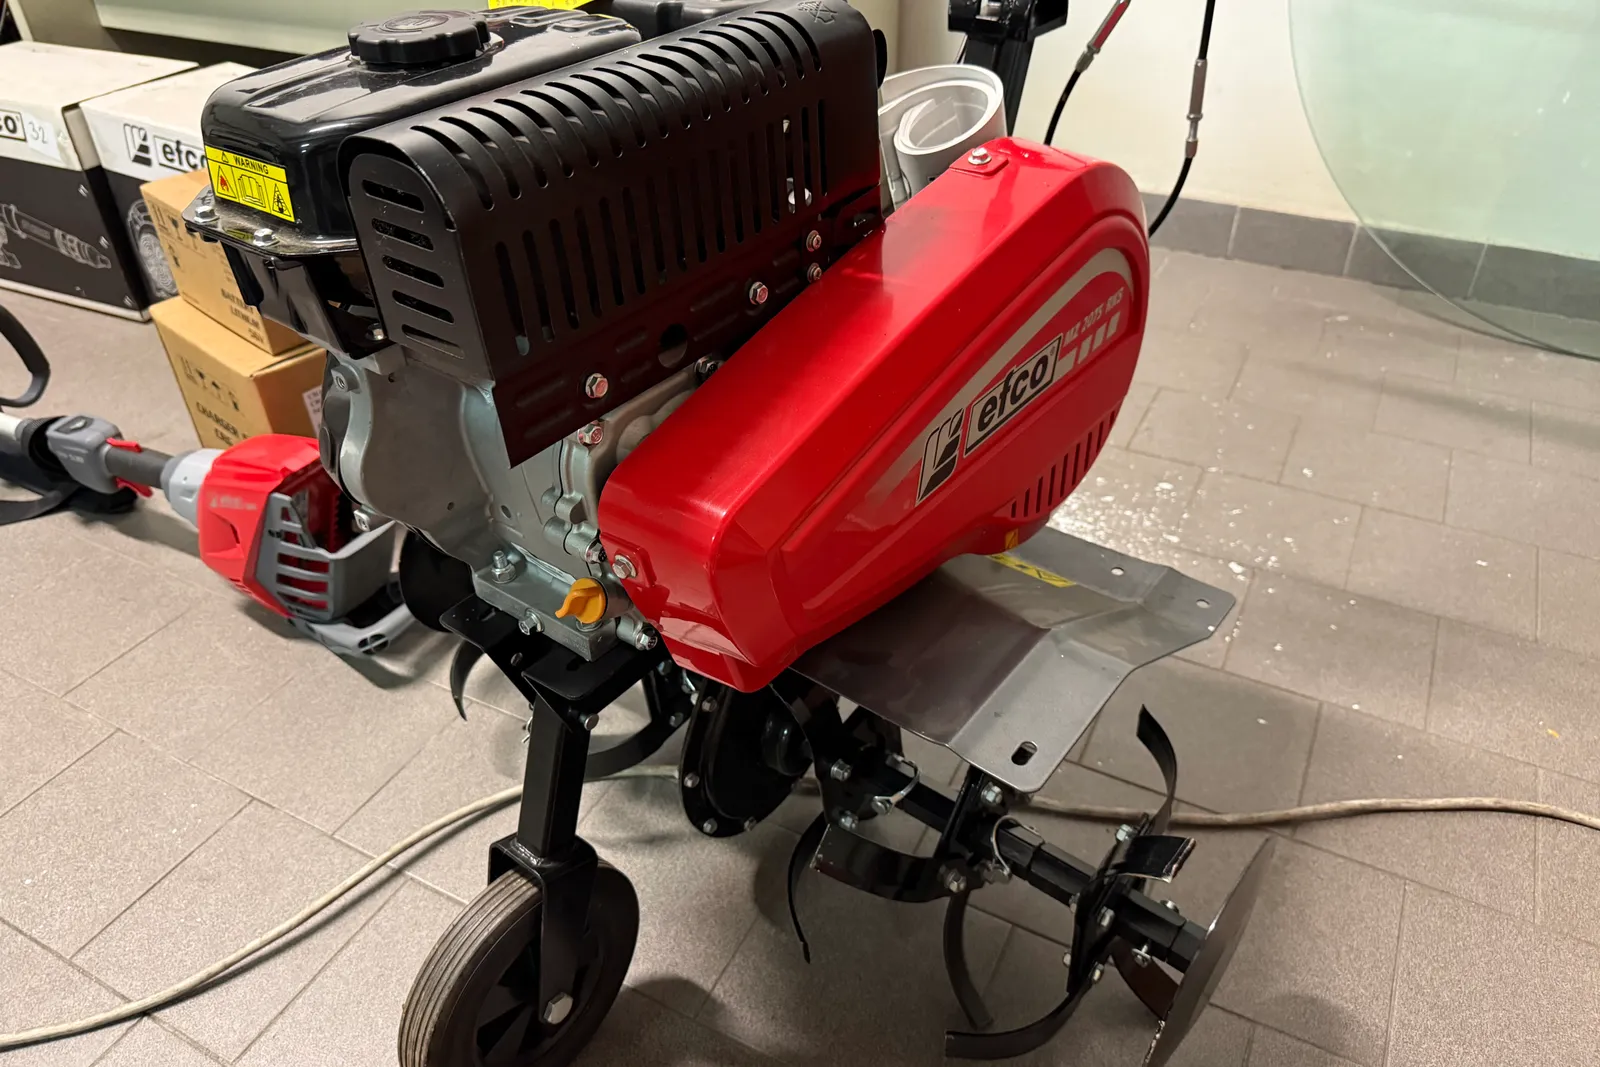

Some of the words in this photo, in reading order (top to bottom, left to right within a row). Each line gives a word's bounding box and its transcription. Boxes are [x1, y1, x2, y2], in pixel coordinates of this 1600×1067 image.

[28, 120, 48, 144] 32
[233, 155, 269, 175] WARNING
[977, 354, 1050, 432] efco
